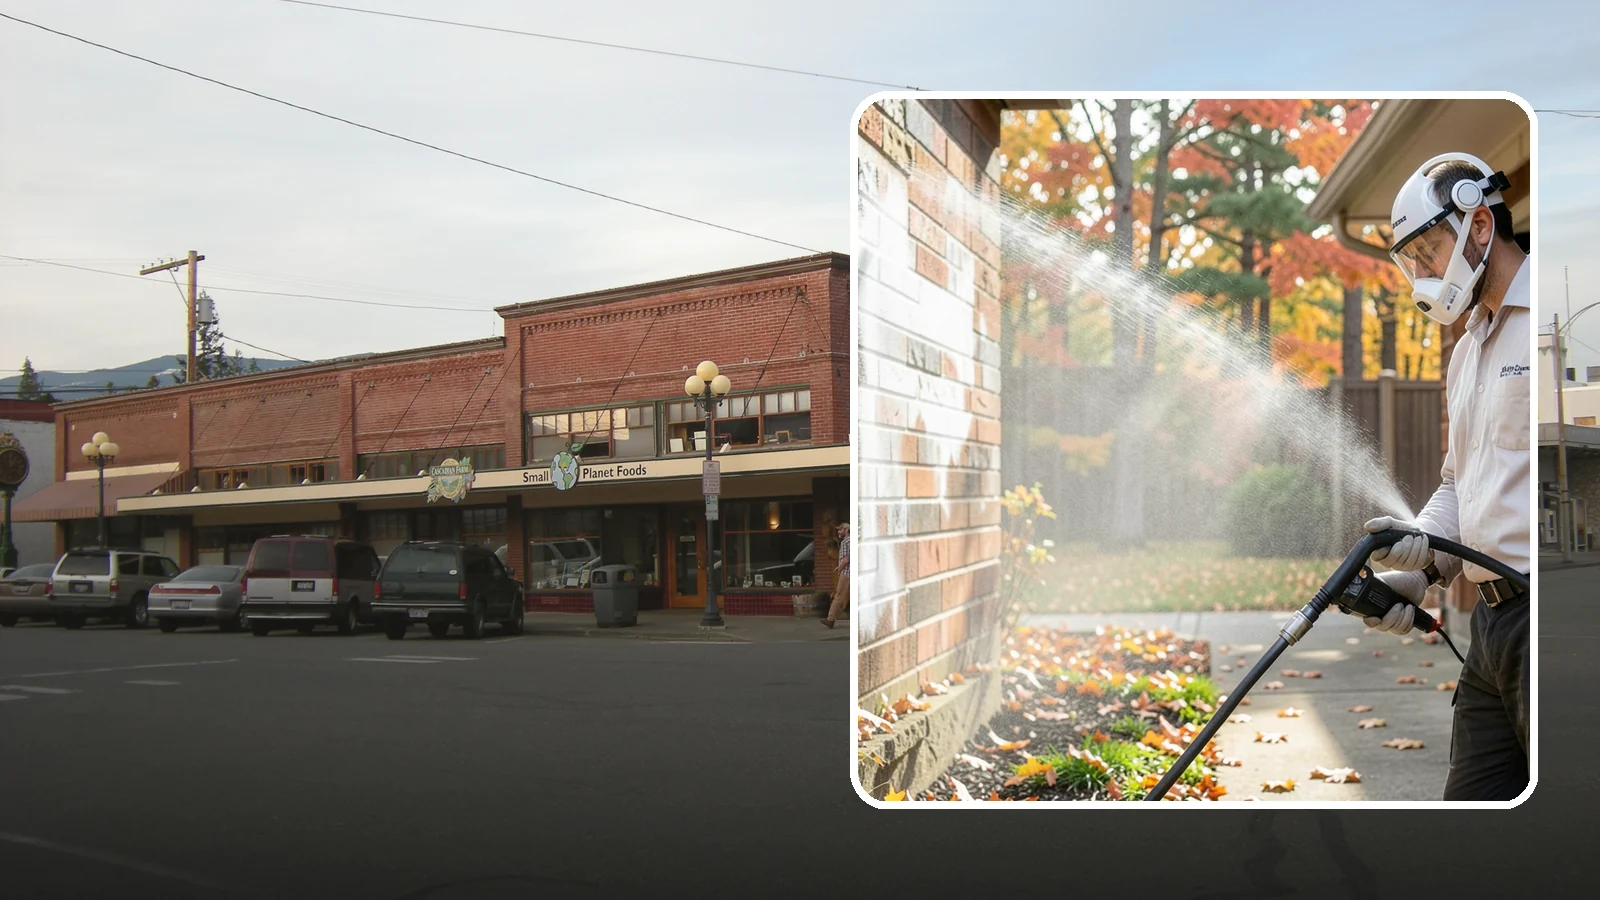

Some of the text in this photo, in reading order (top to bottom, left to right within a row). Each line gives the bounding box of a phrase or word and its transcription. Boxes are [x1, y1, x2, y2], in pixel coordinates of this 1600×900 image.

[523, 464, 647, 483] Small Planet Foods
